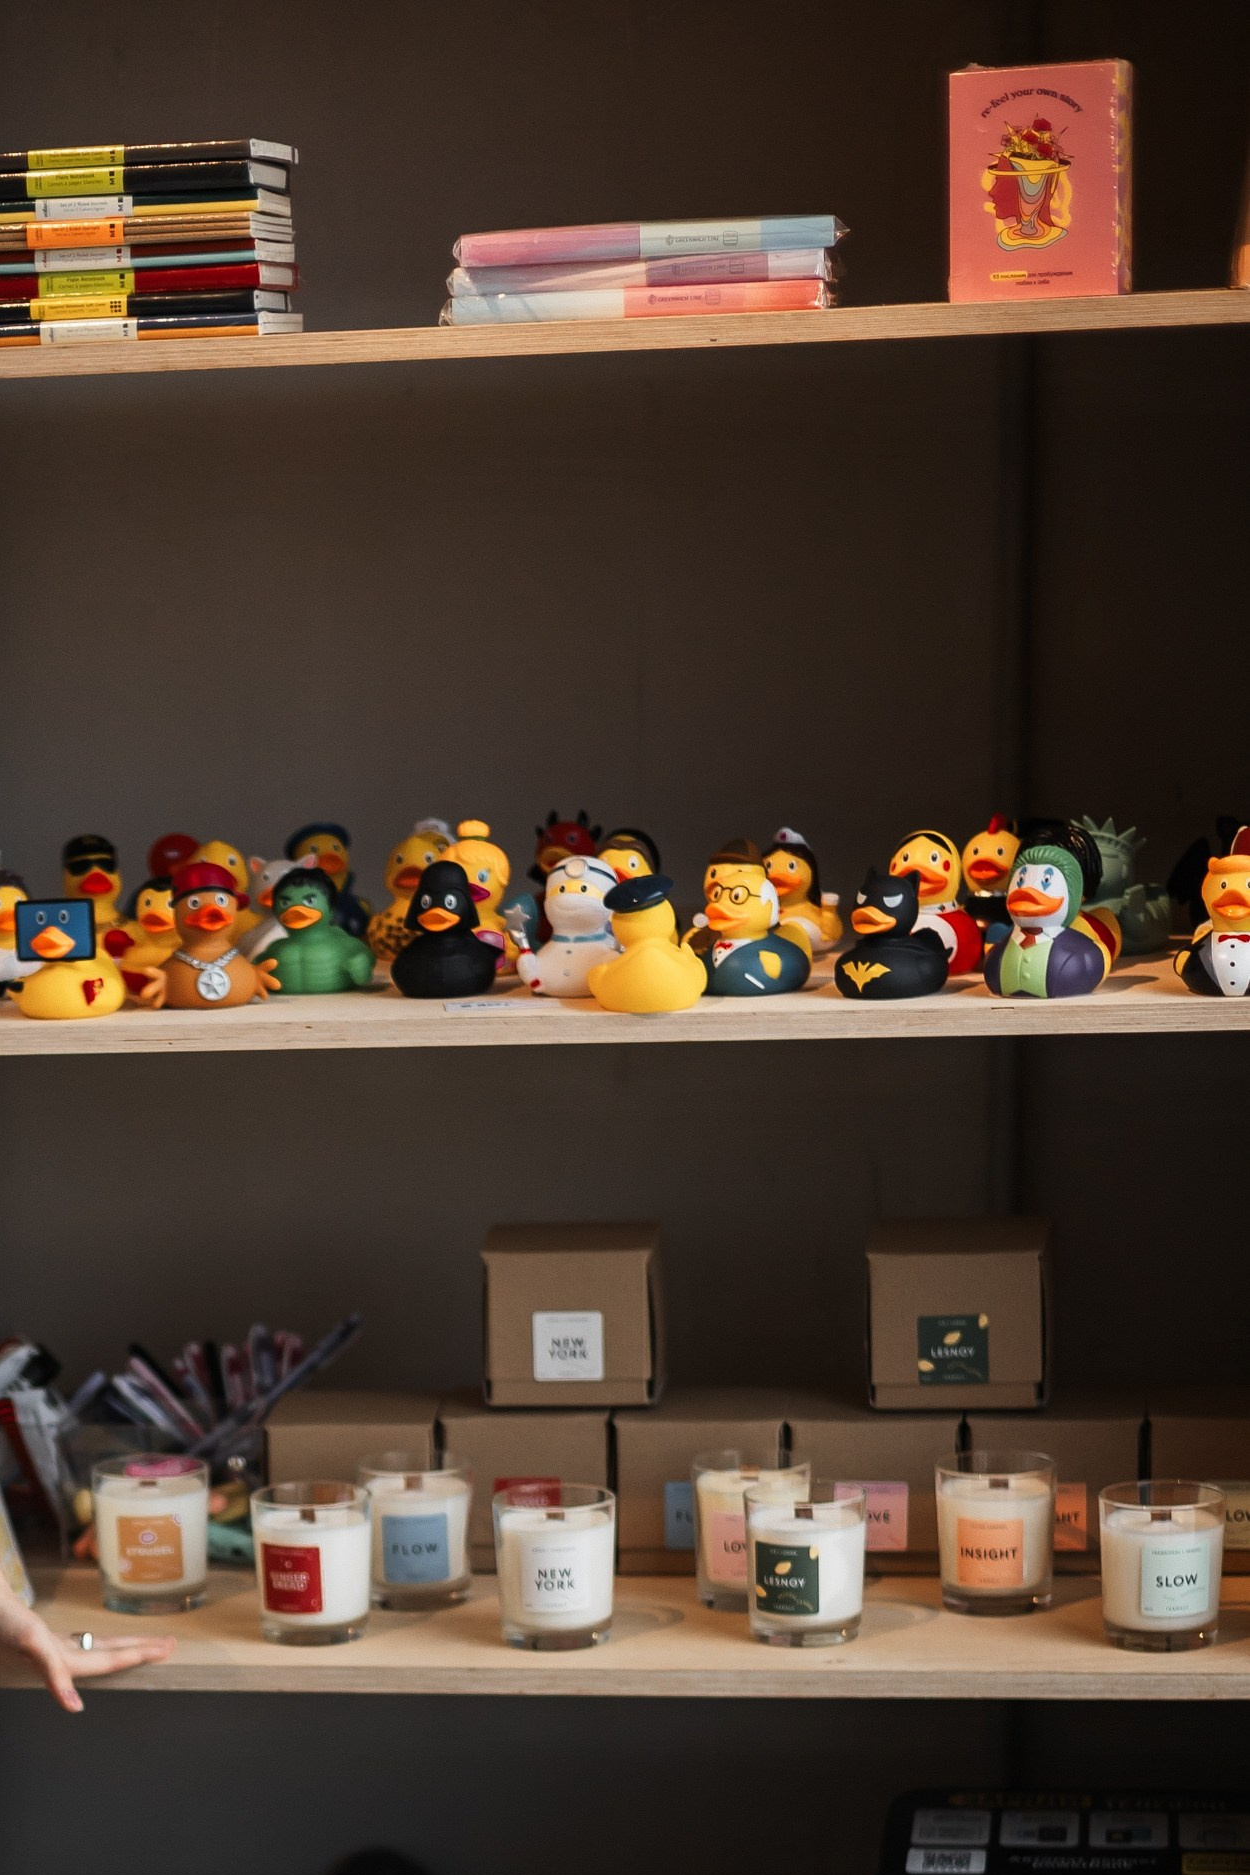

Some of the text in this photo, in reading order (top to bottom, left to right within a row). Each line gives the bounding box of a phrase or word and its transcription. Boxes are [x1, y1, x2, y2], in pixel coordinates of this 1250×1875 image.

[981, 88, 1083, 119] re-feel your own story
[550, 1337, 585, 1348] NEW
[548, 1350, 589, 1360] YORK
[392, 1541, 439, 1556] FLOW
[723, 1539, 747, 1554] LOV
[960, 1546, 1018, 1560] INSIGHT
[537, 1567, 572, 1580] NEW
[1155, 1572, 1198, 1588] SLOW
[535, 1578, 575, 1591] YORK
[763, 1575, 807, 1589] LESNOY
